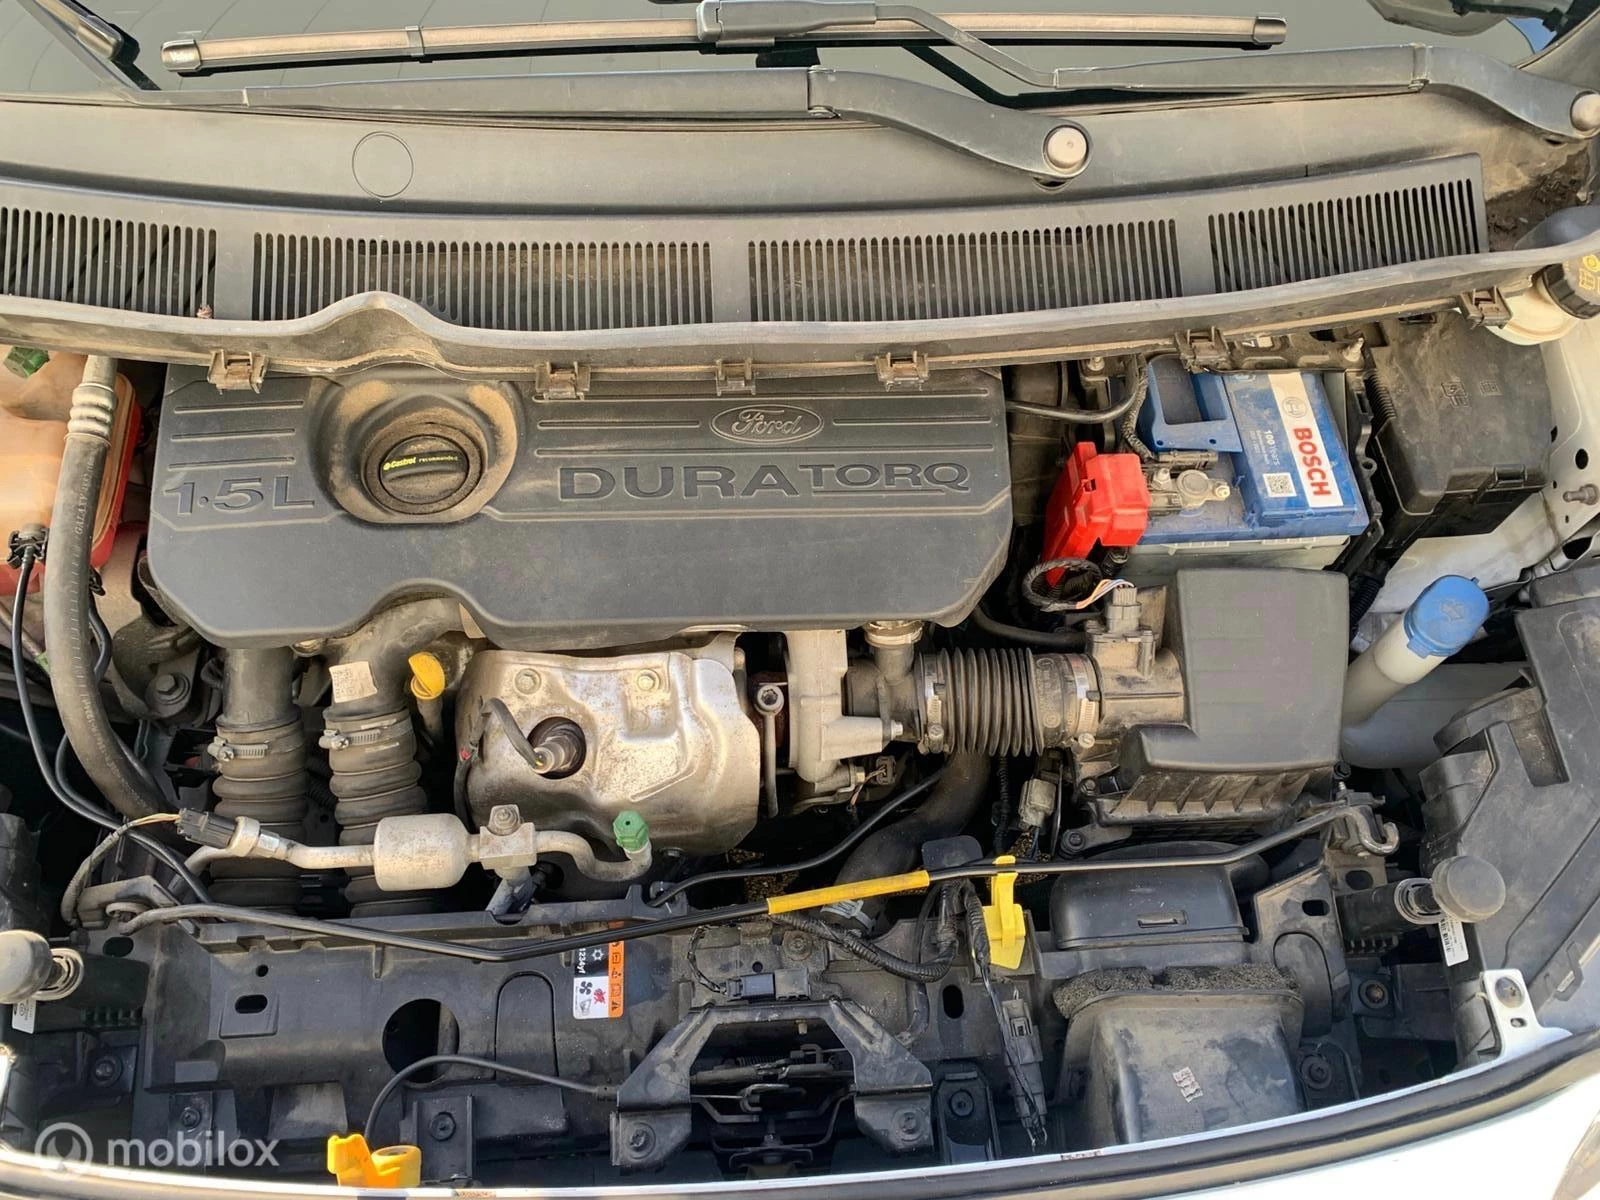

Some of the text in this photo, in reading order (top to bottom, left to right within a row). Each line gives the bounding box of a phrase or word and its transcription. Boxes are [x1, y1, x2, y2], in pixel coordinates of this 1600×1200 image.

[731, 408, 802, 436] Ford
[390, 456, 417, 468] Castrol
[1293, 427, 1332, 497] BOSCH
[559, 462, 970, 502] DURATORQ
